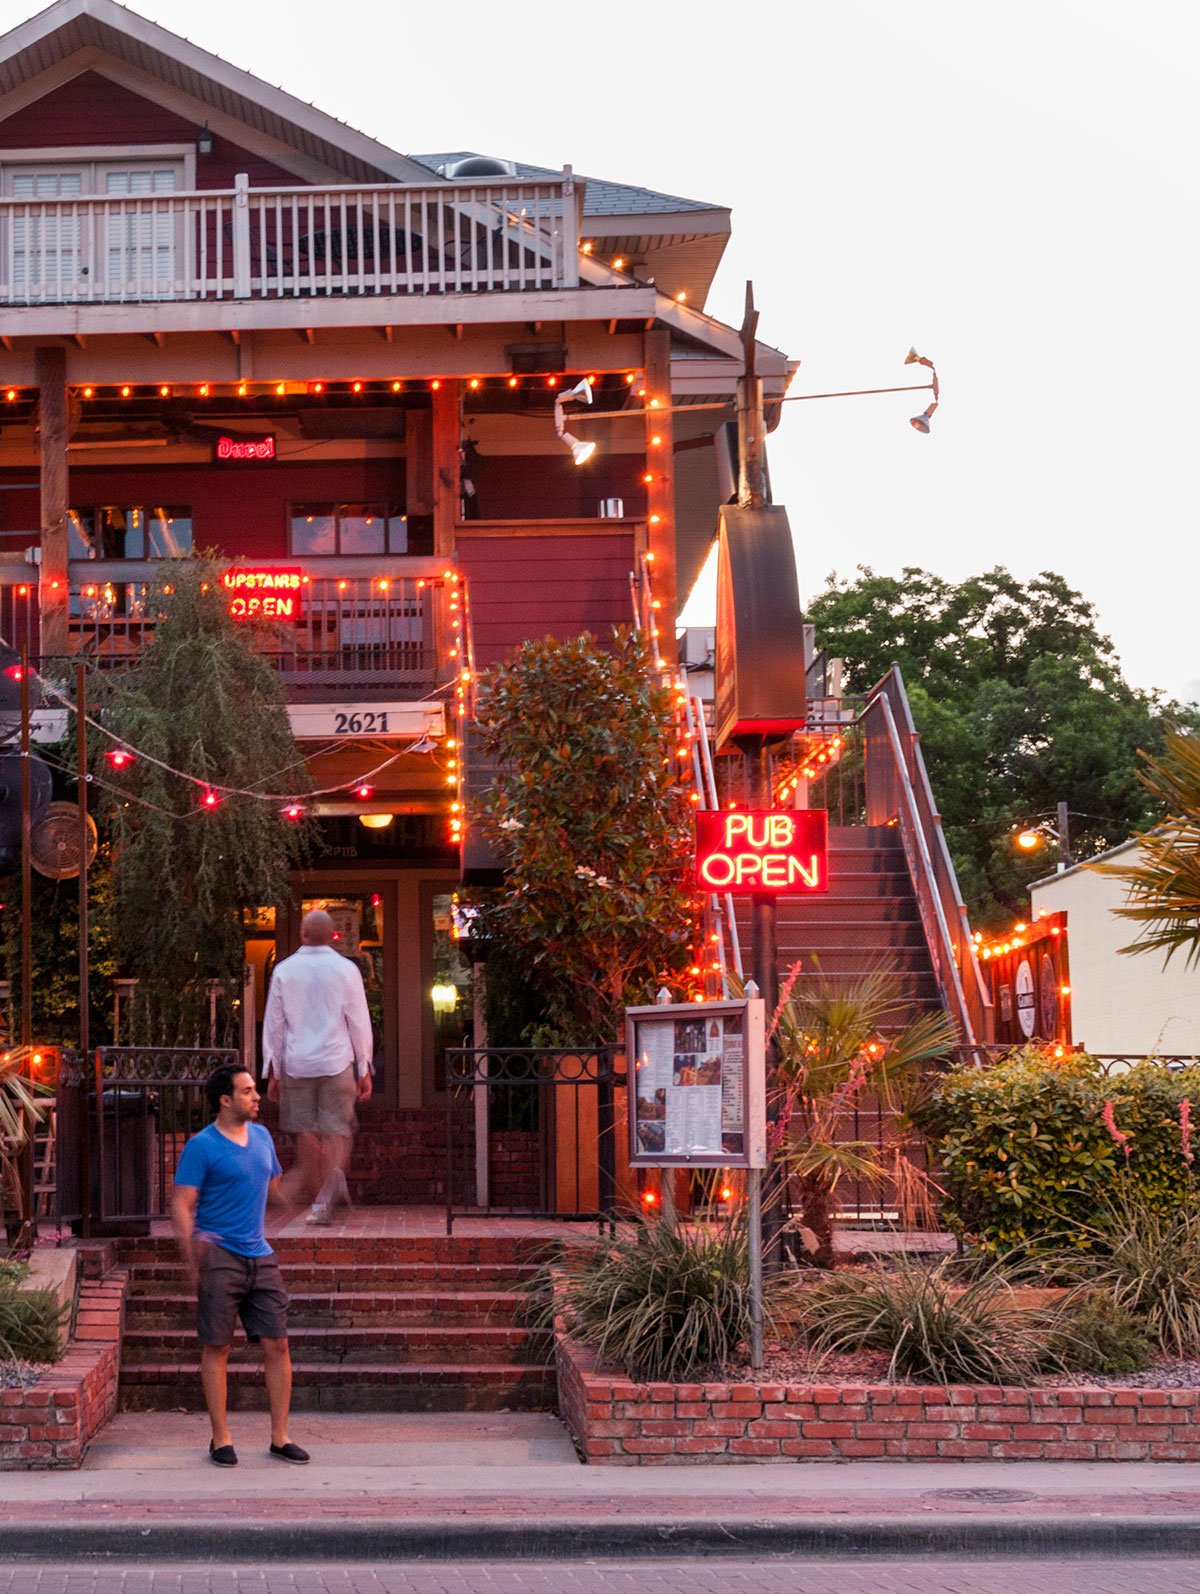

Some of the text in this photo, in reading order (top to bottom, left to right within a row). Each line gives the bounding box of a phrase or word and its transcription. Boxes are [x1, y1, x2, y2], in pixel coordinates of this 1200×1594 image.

[224, 573, 300, 588] UPSTAIRS
[231, 597, 293, 615] OPEN
[334, 711, 389, 733] 2621
[725, 814, 793, 848] PUB
[701, 853, 818, 887] OPEN
